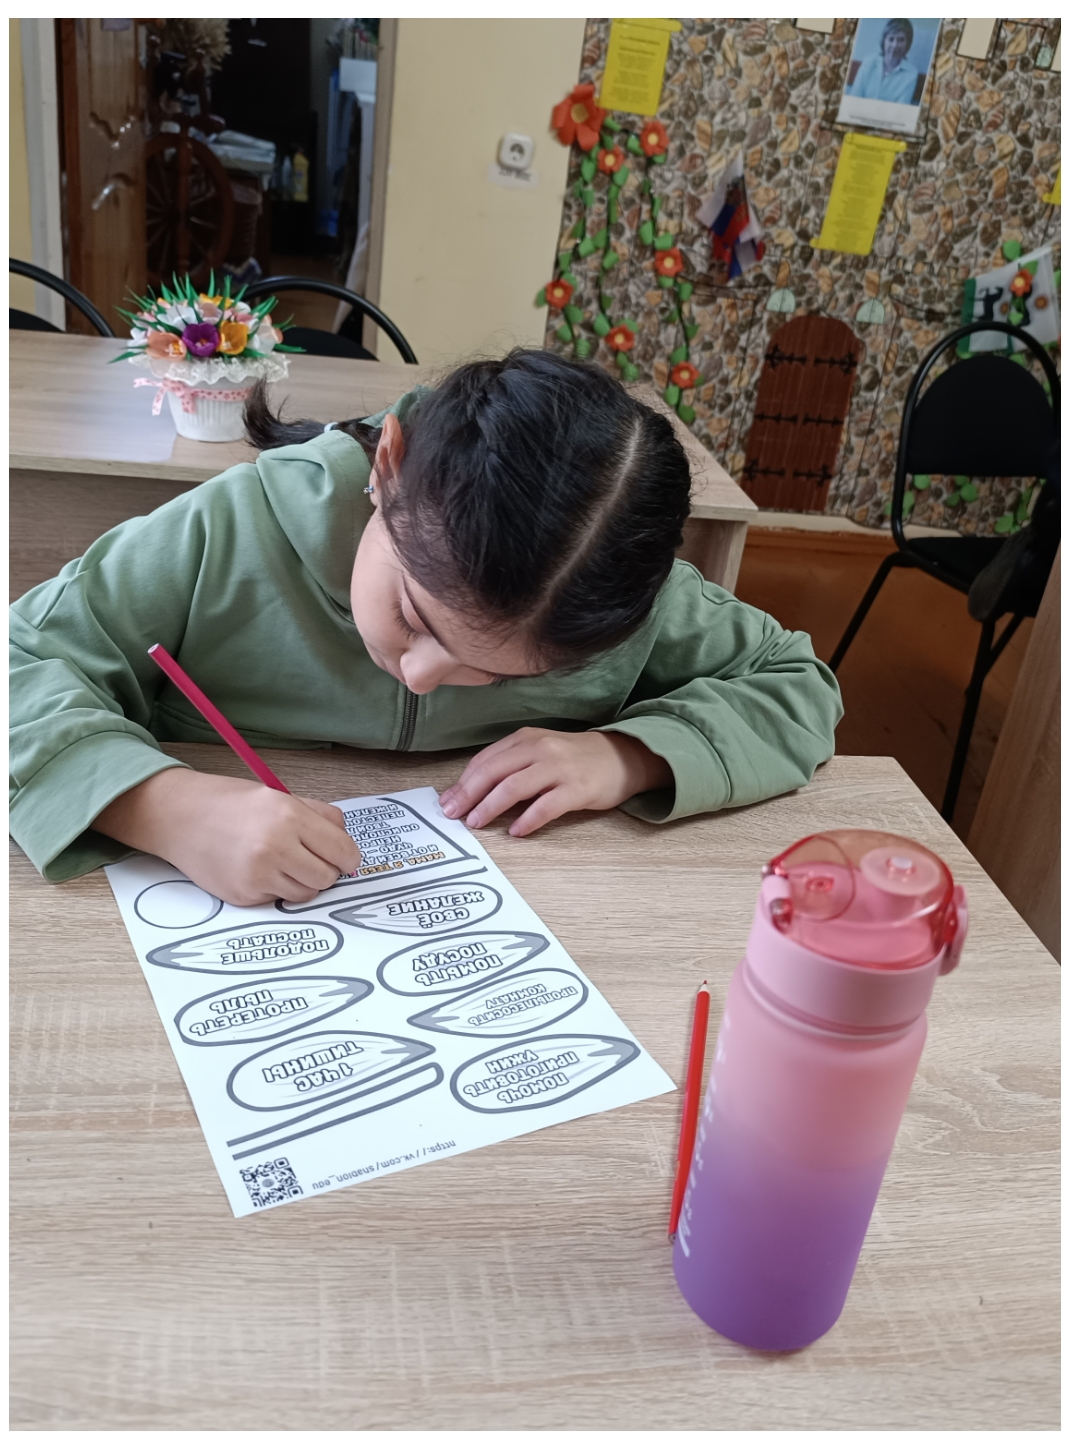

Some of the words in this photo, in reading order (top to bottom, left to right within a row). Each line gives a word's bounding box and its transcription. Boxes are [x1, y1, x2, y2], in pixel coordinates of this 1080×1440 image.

[387, 891, 484, 916] ЖЕЛАНИЕ
[417, 906, 470, 929] СВОЁ
[220, 938, 331, 966] ПОДОЛЬШЕ
[227, 928, 317, 951] ПОСПАТЬ
[411, 941, 489, 974] ПОСУДУ
[413, 953, 504, 988] ПОМЫТЬ
[209, 989, 274, 1015] ПЫЛЬ
[467, 984, 580, 1027] ПРОПЫЛЕСОСИТЬ
[484, 983, 546, 1011] КОМНАТУ
[189, 996, 309, 1037] ПРОТЕРЕТЬ
[262, 1039, 365, 1085] ТИШИНЫ
[462, 1051, 580, 1099] ПРИГОТОВИТЬ
[484, 1048, 539, 1075] УЖИН
[295, 1065, 339, 1094] ЧАС
[496, 1071, 570, 1105] ПОМОЧЬ
